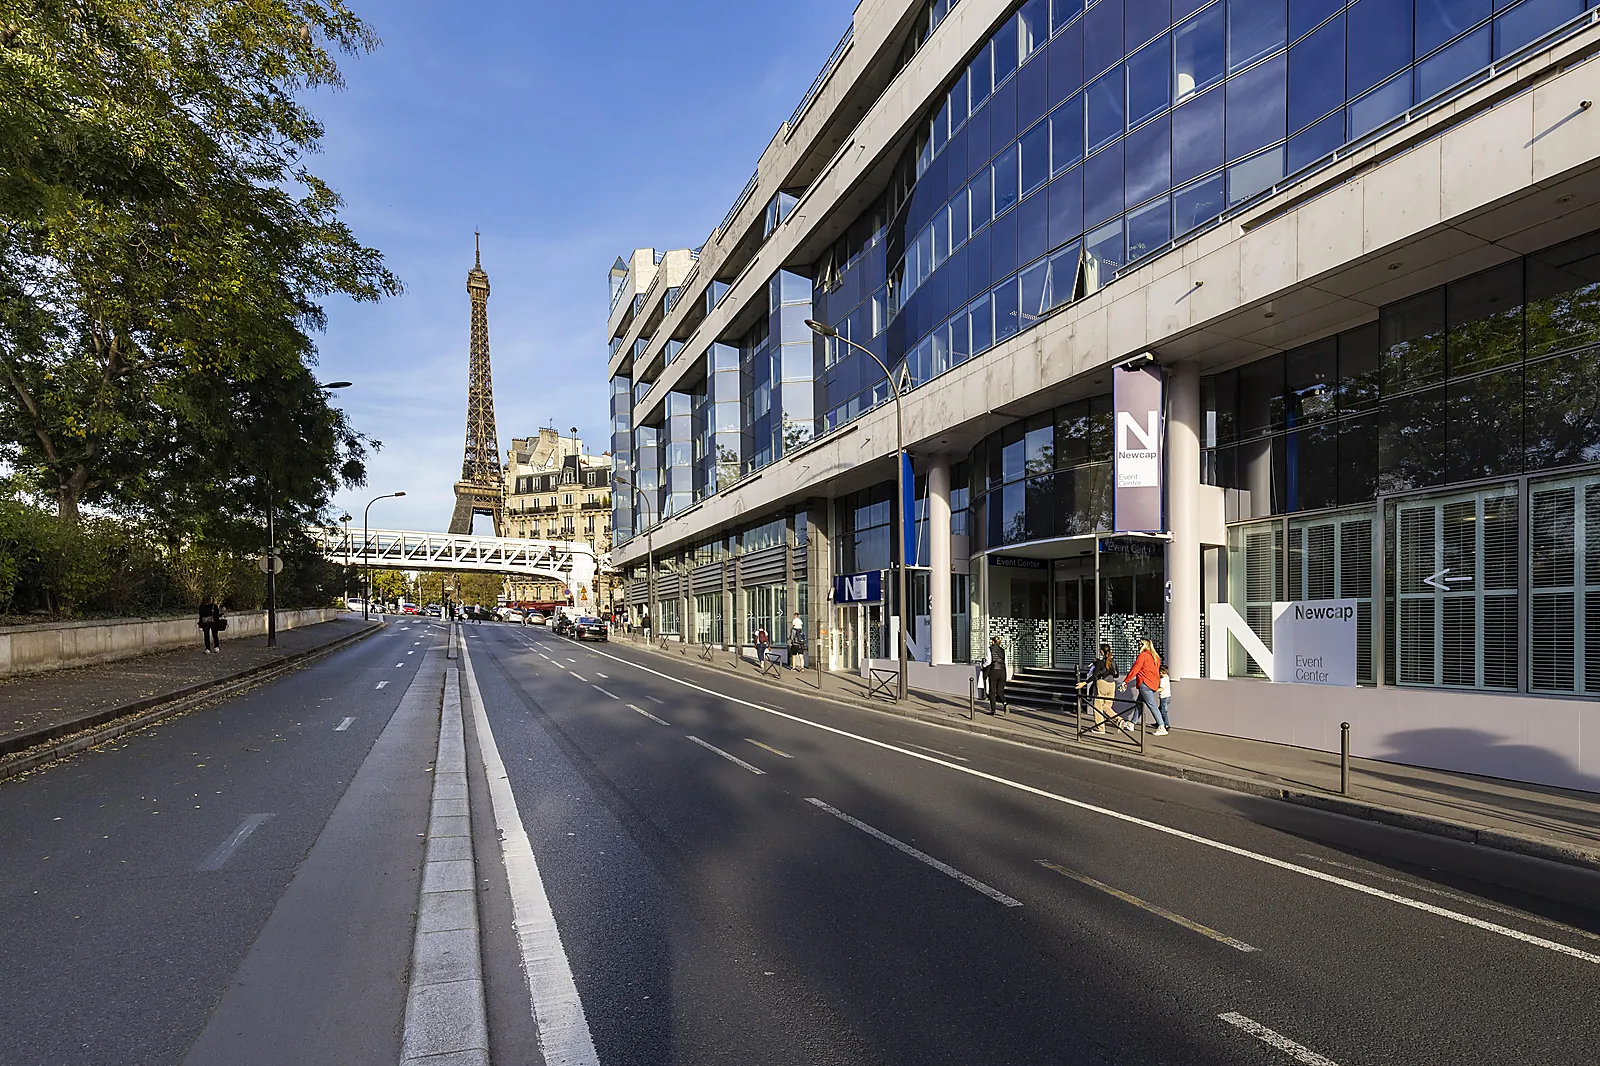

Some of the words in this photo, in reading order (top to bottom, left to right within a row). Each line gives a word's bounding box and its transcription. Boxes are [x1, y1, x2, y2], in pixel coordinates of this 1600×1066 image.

[1118, 410, 1158, 450] N
[1118, 451, 1157, 460] Newcap
[996, 556, 1016, 566] Event
[1017, 558, 1040, 568] Center
[1165, 580, 1173, 603] 3
[1295, 605, 1353, 621] Newcap
[1210, 602, 1294, 683] N
[1295, 655, 1323, 668] Event
[1295, 668, 1329, 682] Center
